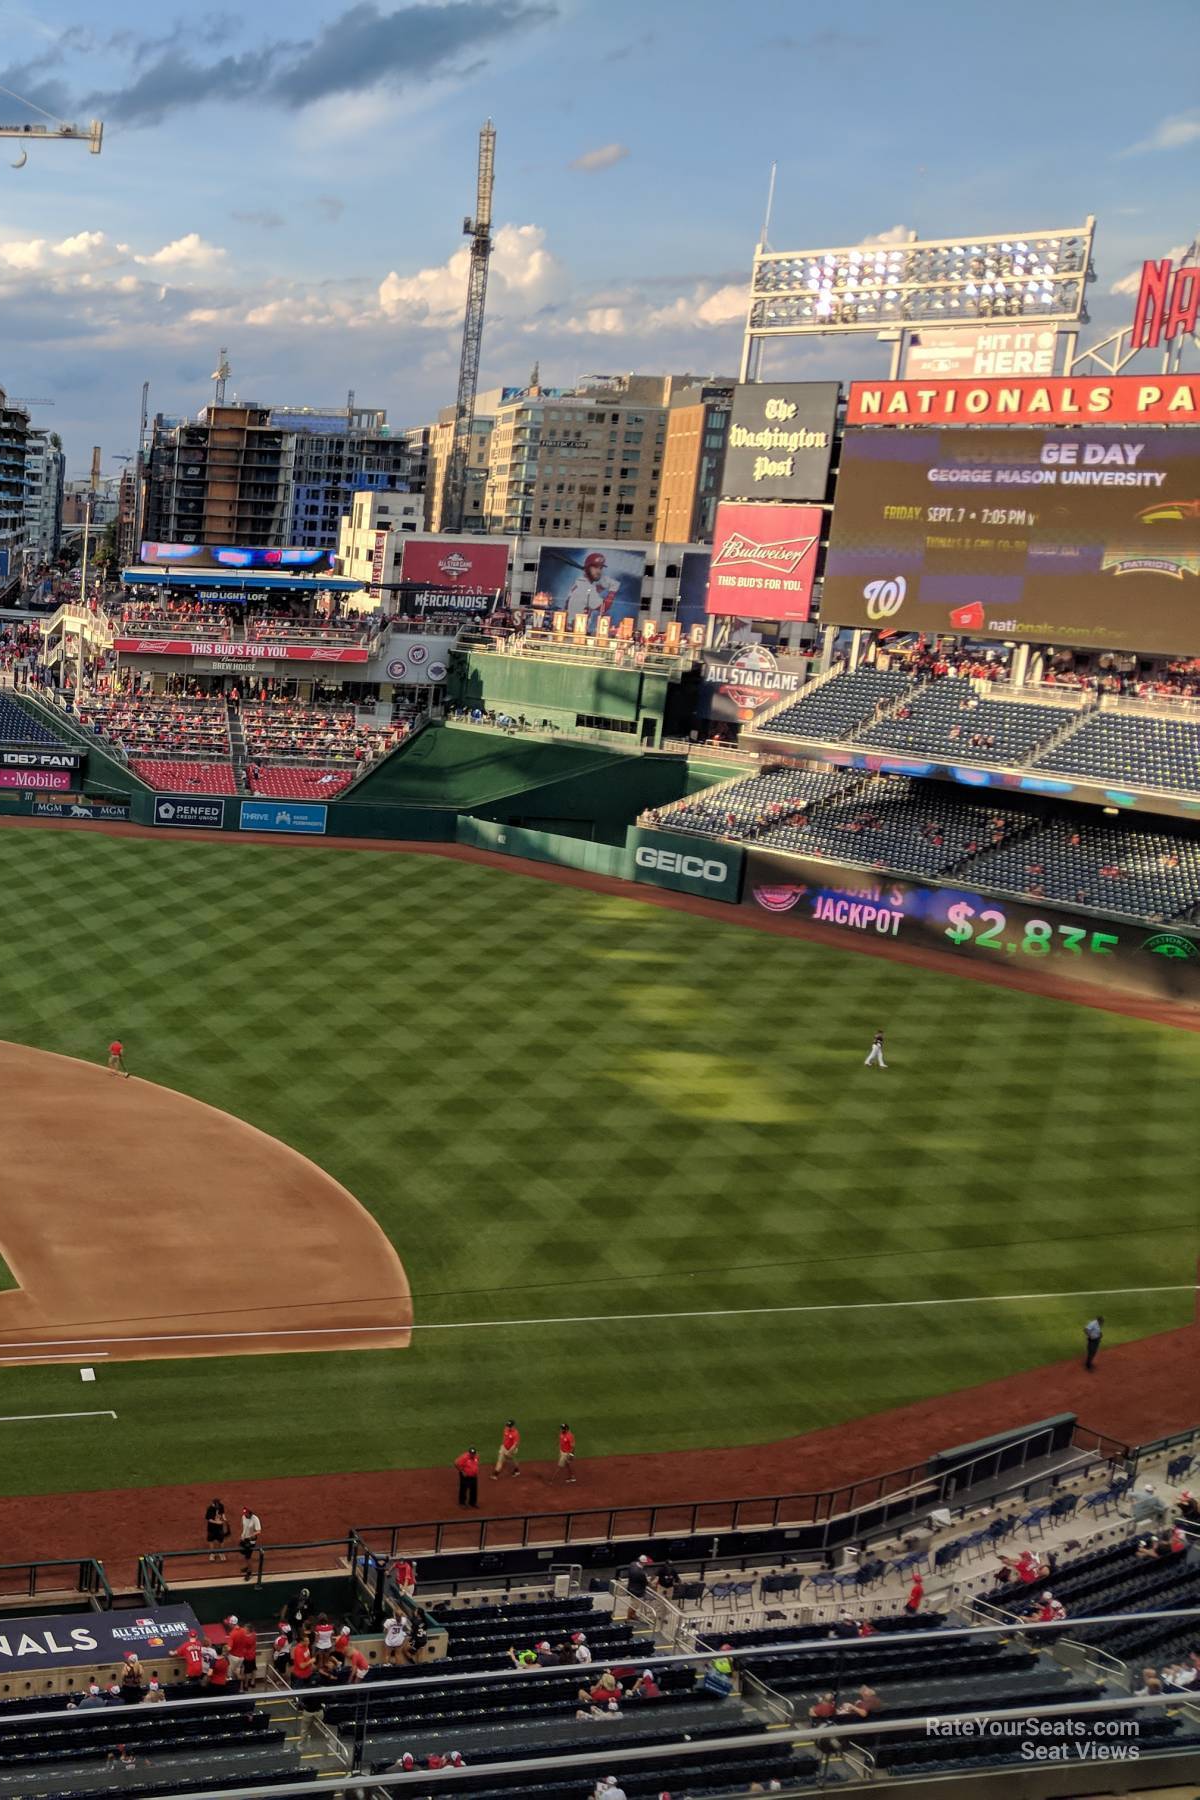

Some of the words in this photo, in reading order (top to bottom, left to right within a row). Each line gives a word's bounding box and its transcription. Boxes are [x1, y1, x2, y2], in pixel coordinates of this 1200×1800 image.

[977, 333, 1011, 350] HIT
[1014, 333, 1036, 349] IT
[974, 350, 1053, 374] HERE
[860, 386, 1113, 413] NATIONALS
[765, 398, 798, 421] The
[729, 423, 827, 452] Washington
[1082, 443, 1145, 465] DAY
[753, 456, 794, 481] Post
[927, 468, 992, 483] GEORGE
[996, 470, 1056, 484] MASON
[1059, 471, 1167, 486] UNIVERSITY
[927, 507, 955, 522] SEPT.
[957, 508, 966, 522] 7
[981, 509, 1006, 524] 7:05
[1007, 510, 1026, 525] PM
[722, 541, 802, 560] Budweiser
[718, 576, 736, 586] THIS
[737, 577, 763, 588] BUD'S
[764, 579, 781, 589] FOR
[783, 580, 803, 591] YOU.
[200, 591, 217, 599] BUD
[219, 592, 244, 600] LIGHT
[415, 590, 488, 608] MERCHANDISE
[191, 643, 212, 654] THIS
[214, 644, 244, 656] BUD'S
[246, 645, 265, 656] FOR
[267, 646, 288, 657] YOU.
[212, 661, 232, 670] BREW
[234, 663, 256, 671] HOUSE
[706, 665, 728, 682] ALL
[730, 668, 761, 687] STAR
[764, 671, 798, 691] GAME
[41, 755, 74, 766] FAN
[38, 804, 62, 812] MGM
[101, 807, 125, 815] MGM
[176, 805, 219, 816] PENFED
[243, 812, 268, 821] THRIVE
[635, 846, 728, 882] GEICO
[812, 895, 904, 936] JACKPOT
[112, 1627, 132, 1638] ALL
[132, 1625, 159, 1635] STAR
[160, 1623, 189, 1633] GAME
[190, 1650, 199, 1662] 11
